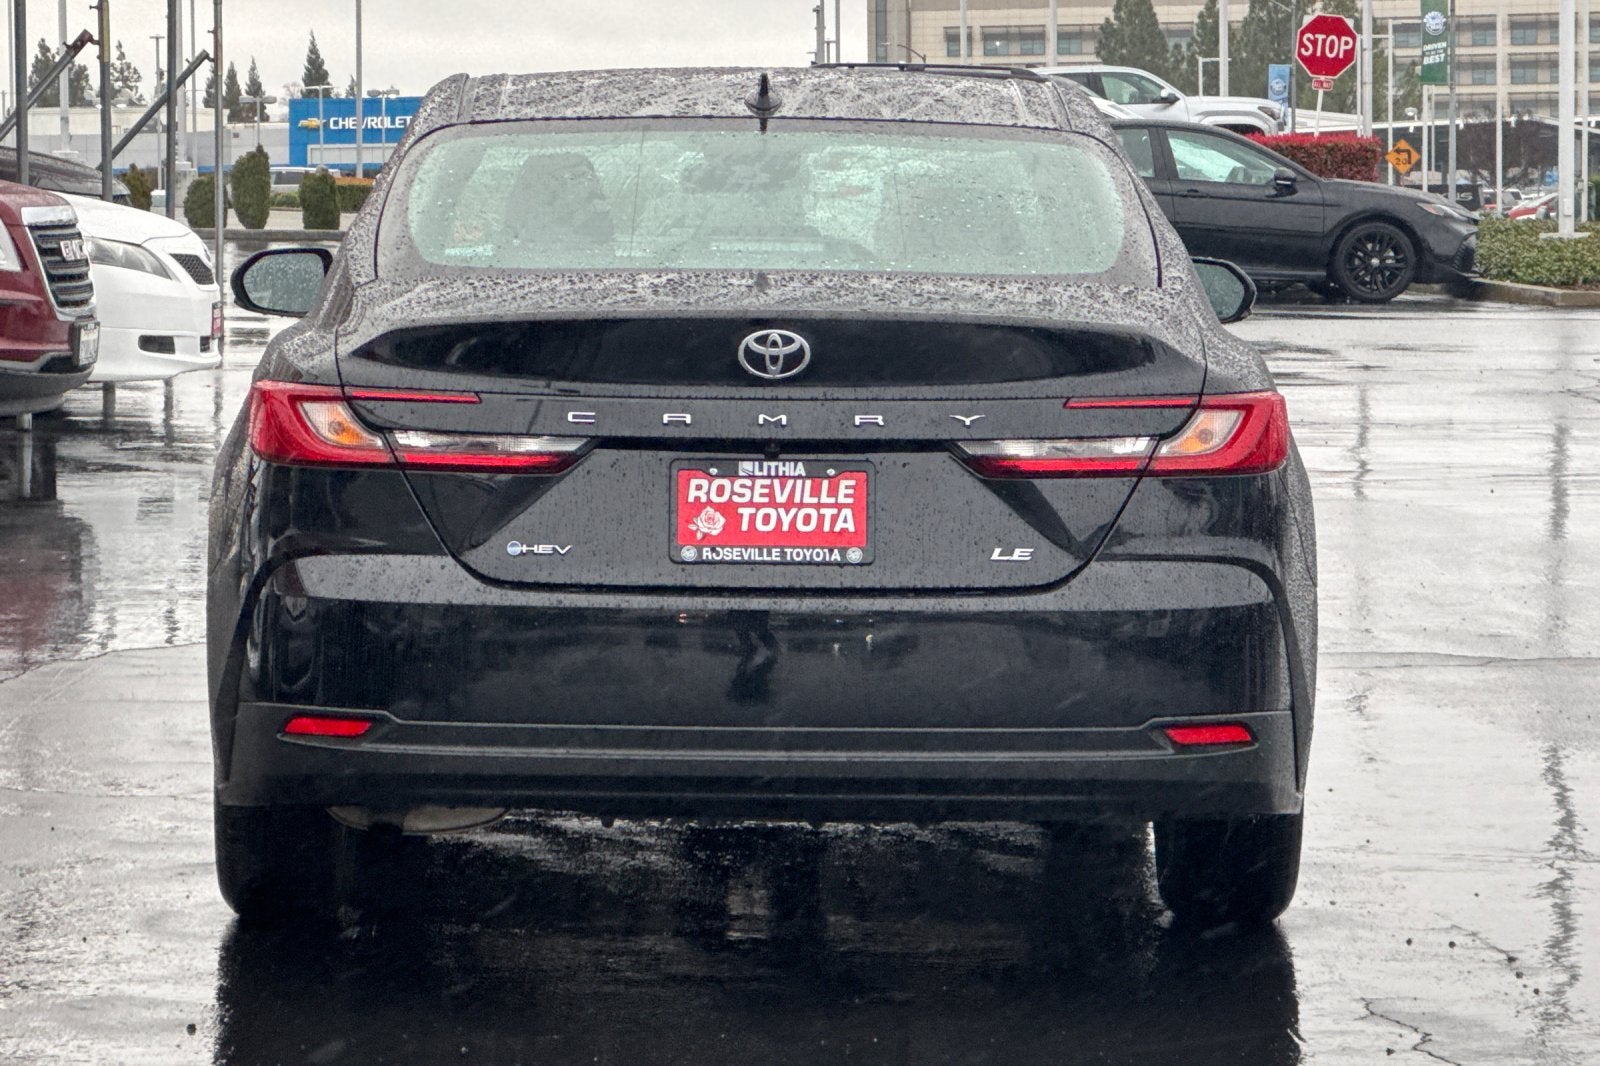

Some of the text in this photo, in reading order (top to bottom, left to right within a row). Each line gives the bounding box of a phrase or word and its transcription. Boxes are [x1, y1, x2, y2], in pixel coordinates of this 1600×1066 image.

[1301, 33, 1353, 59] STOP
[1423, 41, 1447, 51] DRIVEN
[1423, 53, 1446, 65] BEST
[1395, 157, 1408, 165] 20
[567, 411, 986, 426] CAMRY
[753, 462, 807, 477] LITHIA
[687, 478, 857, 504] ROSEVILLE
[737, 507, 856, 533] TOYOTA
[522, 544, 573, 555] HEV
[702, 547, 841, 562] ROSEVILLE TOYOTA
[990, 547, 1034, 561] LE
